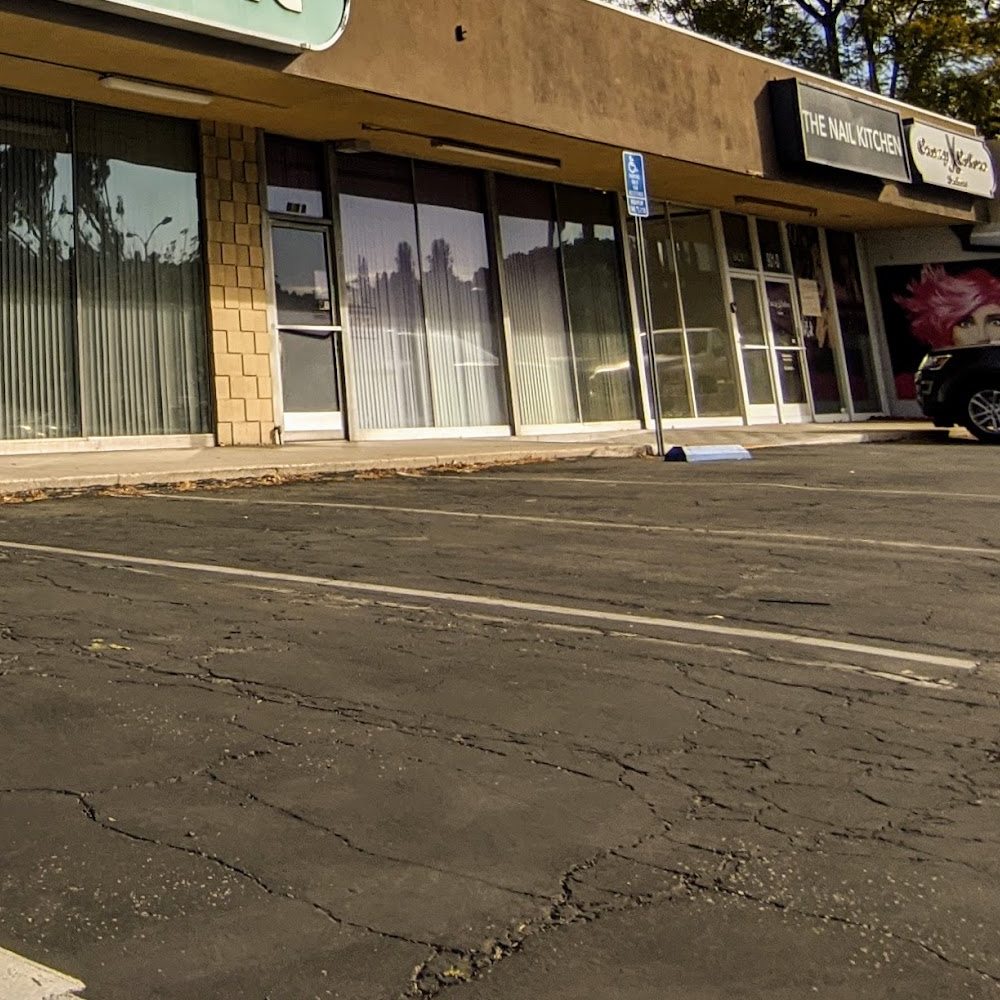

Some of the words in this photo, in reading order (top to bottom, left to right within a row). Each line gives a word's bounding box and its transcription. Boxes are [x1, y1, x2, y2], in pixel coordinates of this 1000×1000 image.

[802, 109, 827, 138] THE
[828, 117, 856, 147] NAIL
[857, 126, 903, 157] KITCHEN
